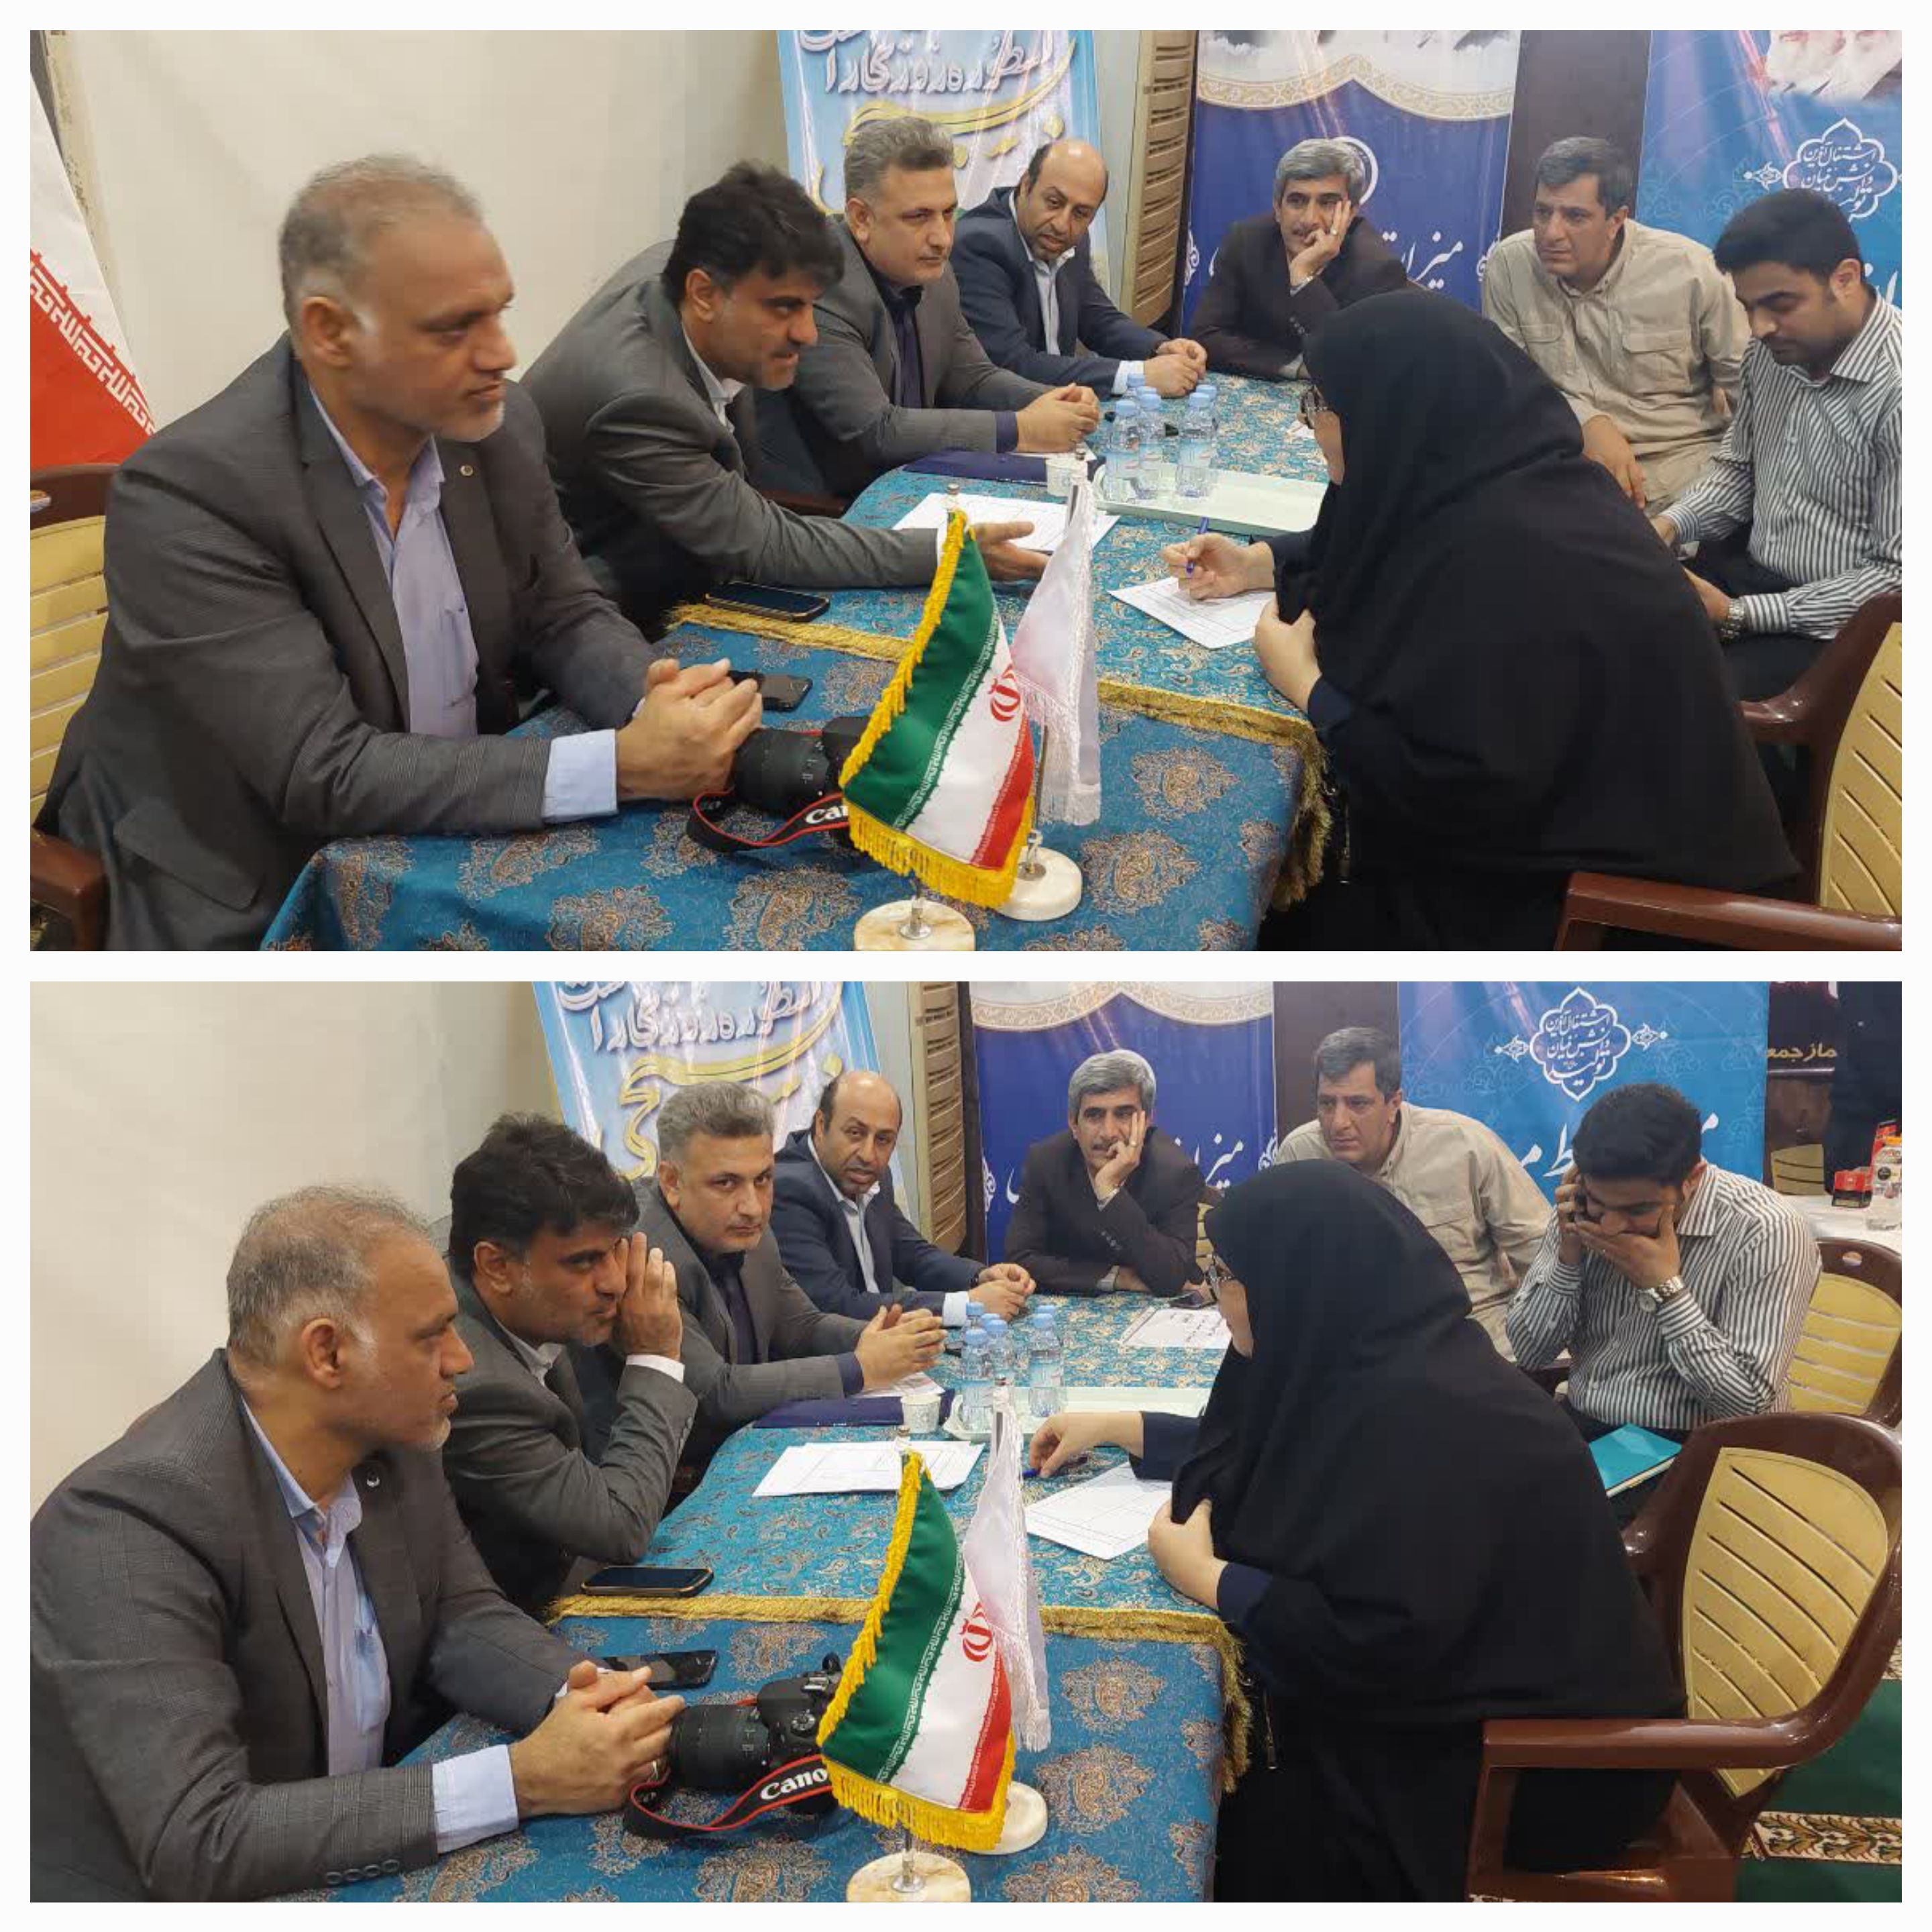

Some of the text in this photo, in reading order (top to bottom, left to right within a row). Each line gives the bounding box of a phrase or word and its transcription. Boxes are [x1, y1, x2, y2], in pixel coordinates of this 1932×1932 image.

[1766, 1042, 1837, 1063] ماز جمع
[760, 1768, 828, 1800] Cano
